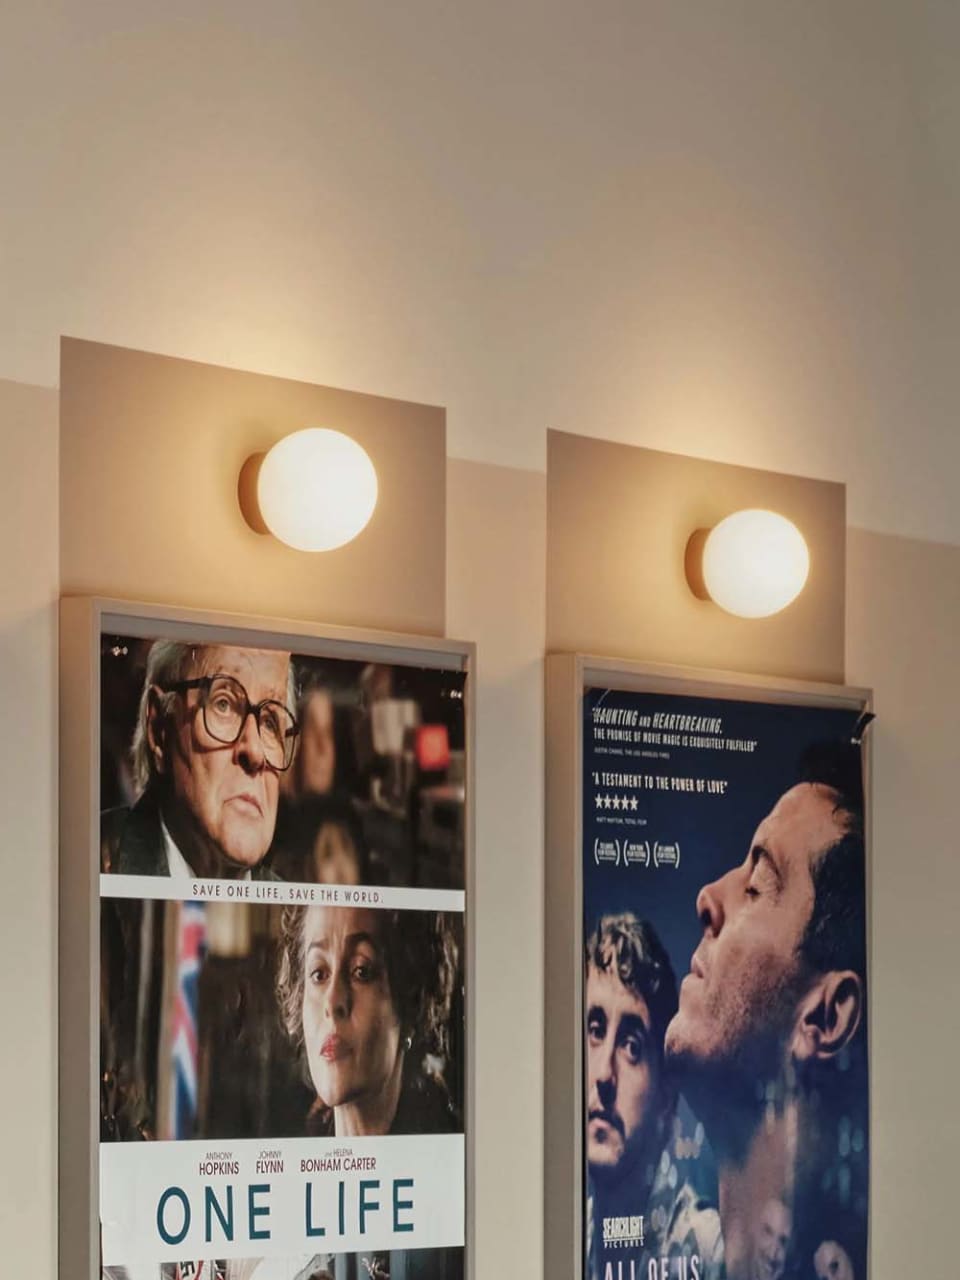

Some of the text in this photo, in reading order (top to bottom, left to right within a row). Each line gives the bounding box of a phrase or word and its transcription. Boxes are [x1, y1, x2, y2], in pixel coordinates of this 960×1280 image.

[653, 712, 722, 734] HEARTBREAKING.
[594, 727, 605, 740] THE
[607, 729, 632, 742] PROMISE
[634, 731, 642, 742] OF
[643, 732, 661, 744] MOVIE
[663, 734, 681, 746] MAGIC
[682, 735, 688, 747] IS
[690, 736, 725, 750] EXQUISITELY
[602, 772, 642, 788] TESTAMENT
[644, 775, 654, 789] TO
[656, 776, 669, 790] THE
[671, 777, 694, 792] POWER
[696, 779, 705, 792] OF
[192, 884, 221, 897] SAVE
[227, 886, 250, 898] ONE
[289, 888, 316, 901] SAVE
[320, 889, 339, 902] THE
[344, 890, 384, 904] WORLD.
[199, 1161, 240, 1176] HOPKINS
[256, 1160, 284, 1174] FLYNN
[300, 1157, 377, 1172] BONHAM CARTER
[156, 1178, 414, 1245] ONE LIFE
